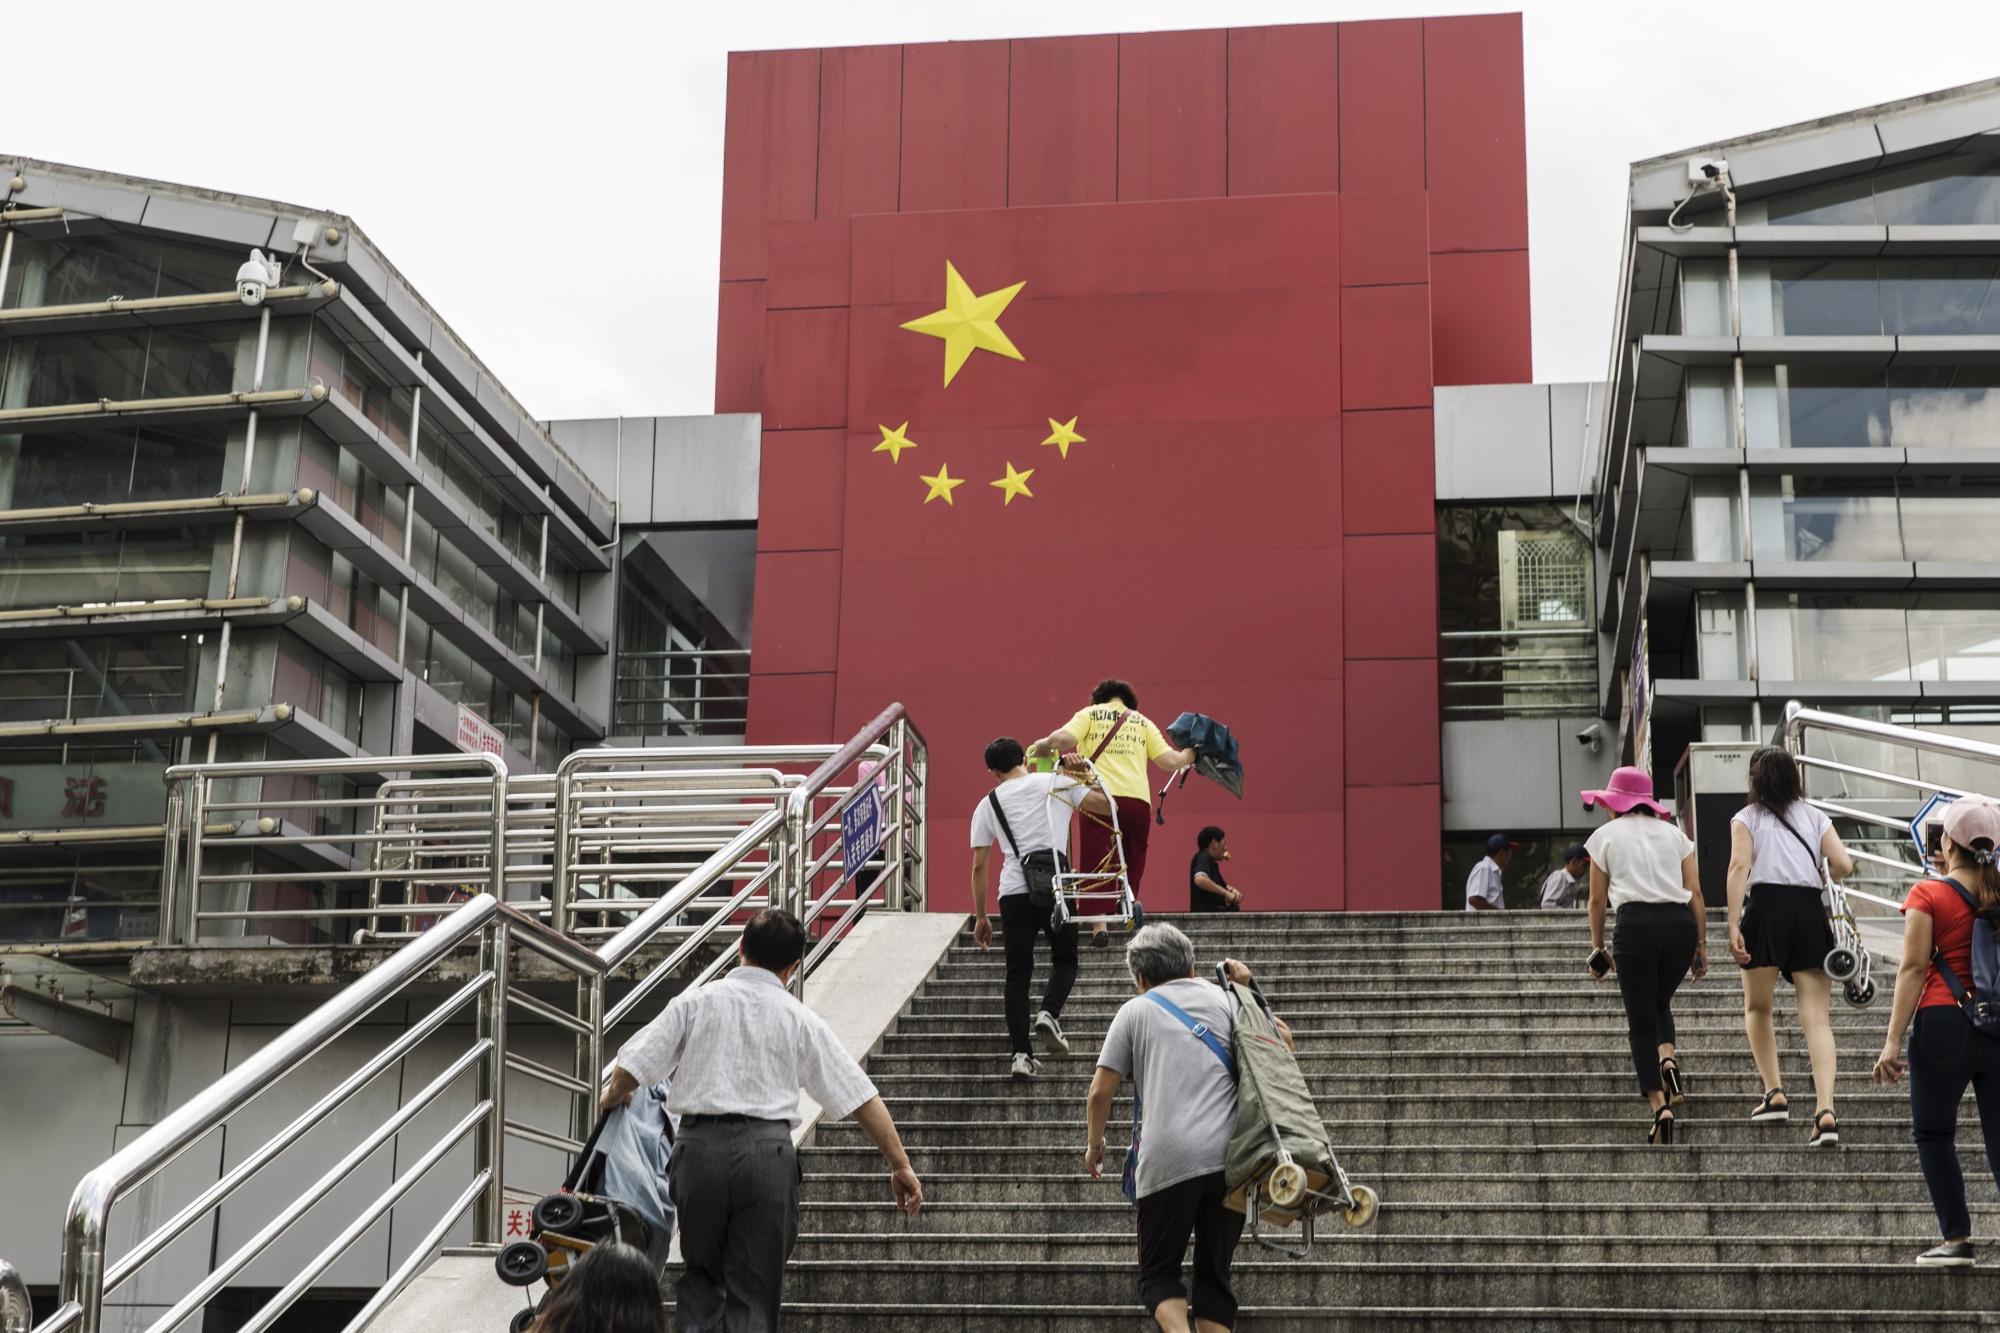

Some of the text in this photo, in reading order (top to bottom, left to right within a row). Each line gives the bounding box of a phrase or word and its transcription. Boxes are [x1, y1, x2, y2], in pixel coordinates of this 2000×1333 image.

[846, 823, 874, 872] 入关专用通道
